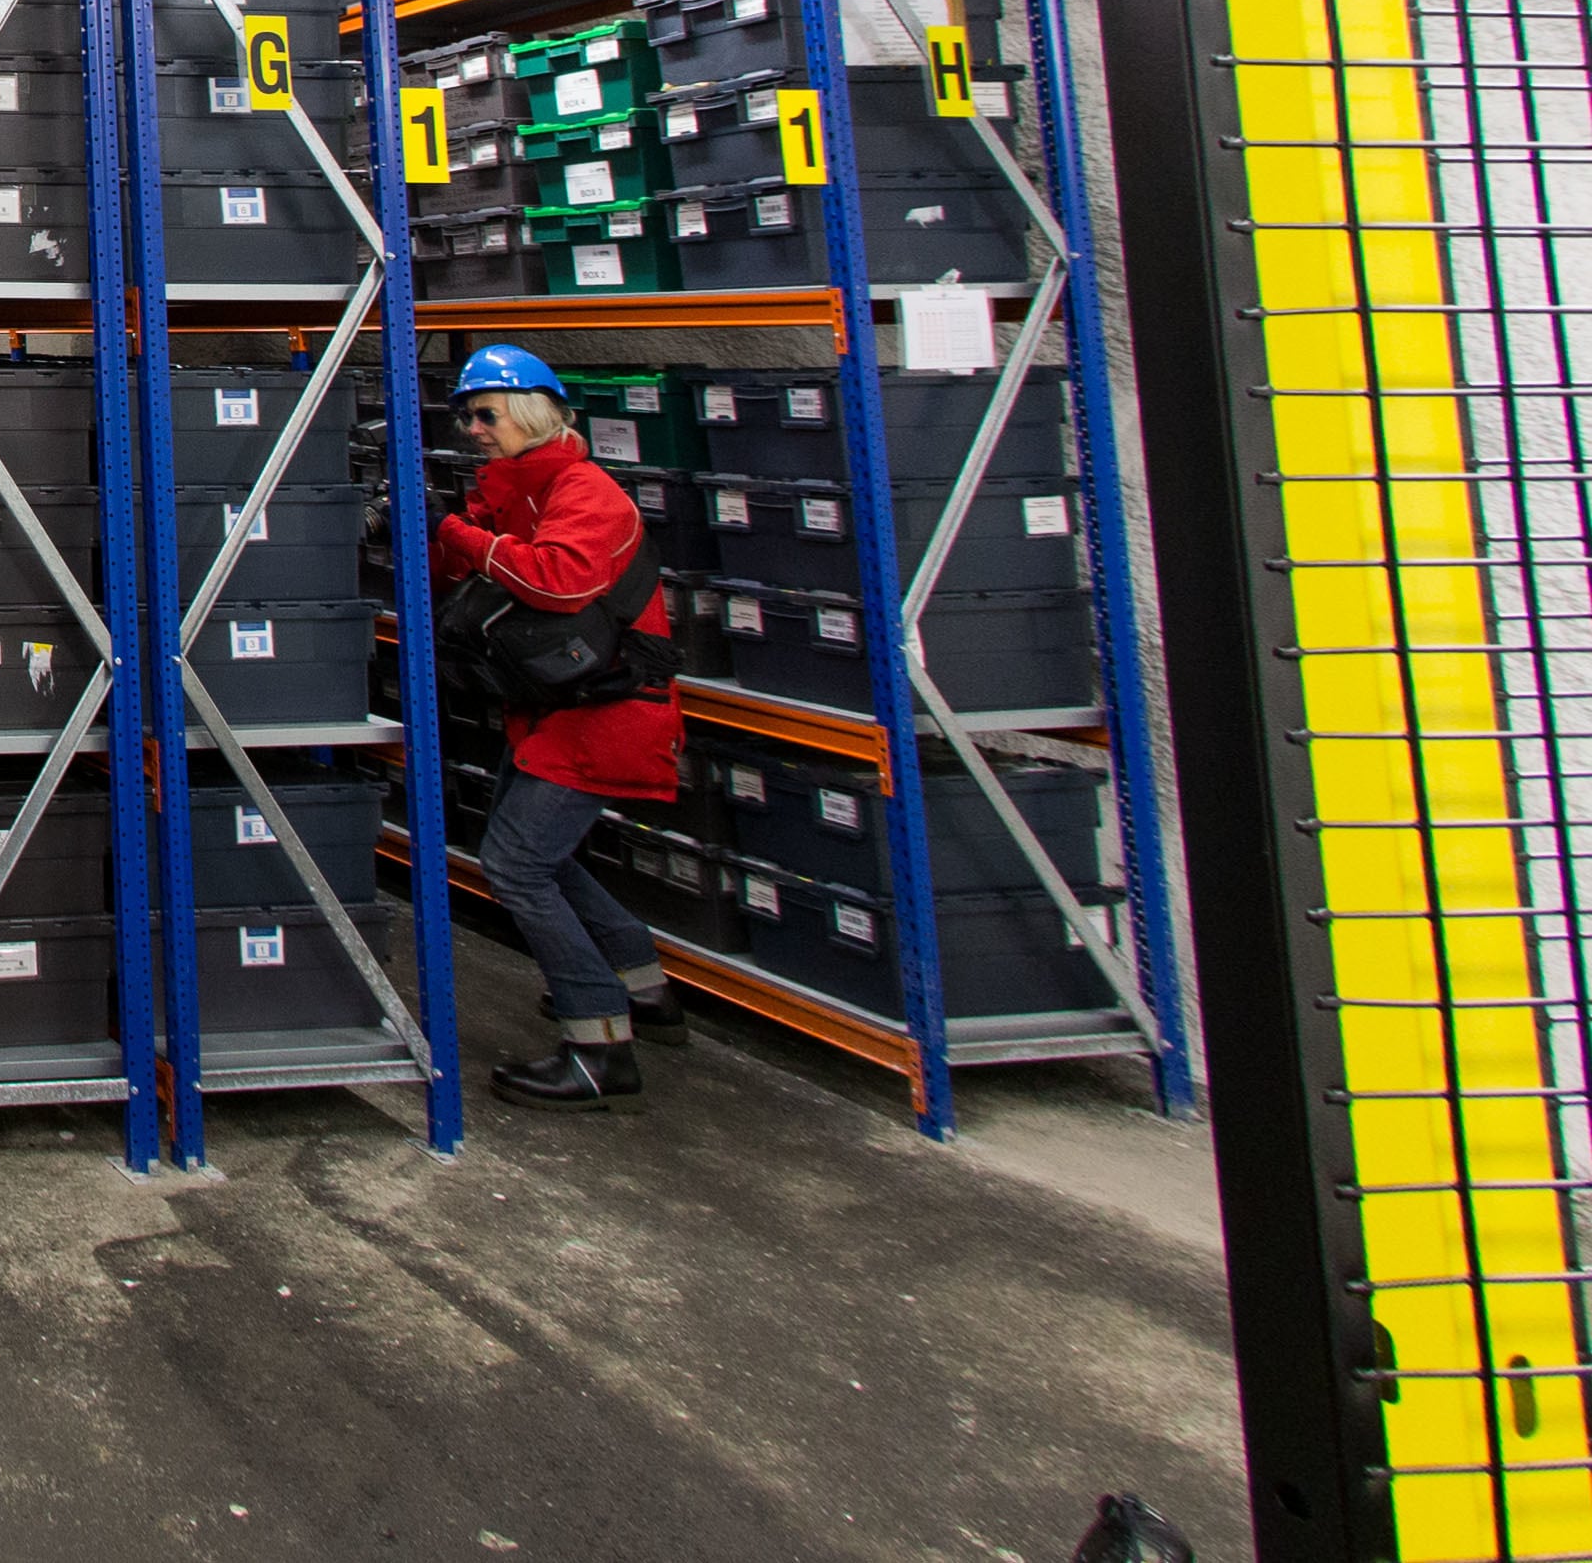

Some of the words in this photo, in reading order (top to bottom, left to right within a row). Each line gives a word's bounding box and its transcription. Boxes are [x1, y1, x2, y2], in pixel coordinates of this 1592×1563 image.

[251, 32, 288, 94] G
[933, 42, 969, 100] H
[412, 107, 437, 165] 1
[791, 109, 815, 167] 1
[583, 271, 600, 279] BOX
[599, 445, 617, 455] BOX
